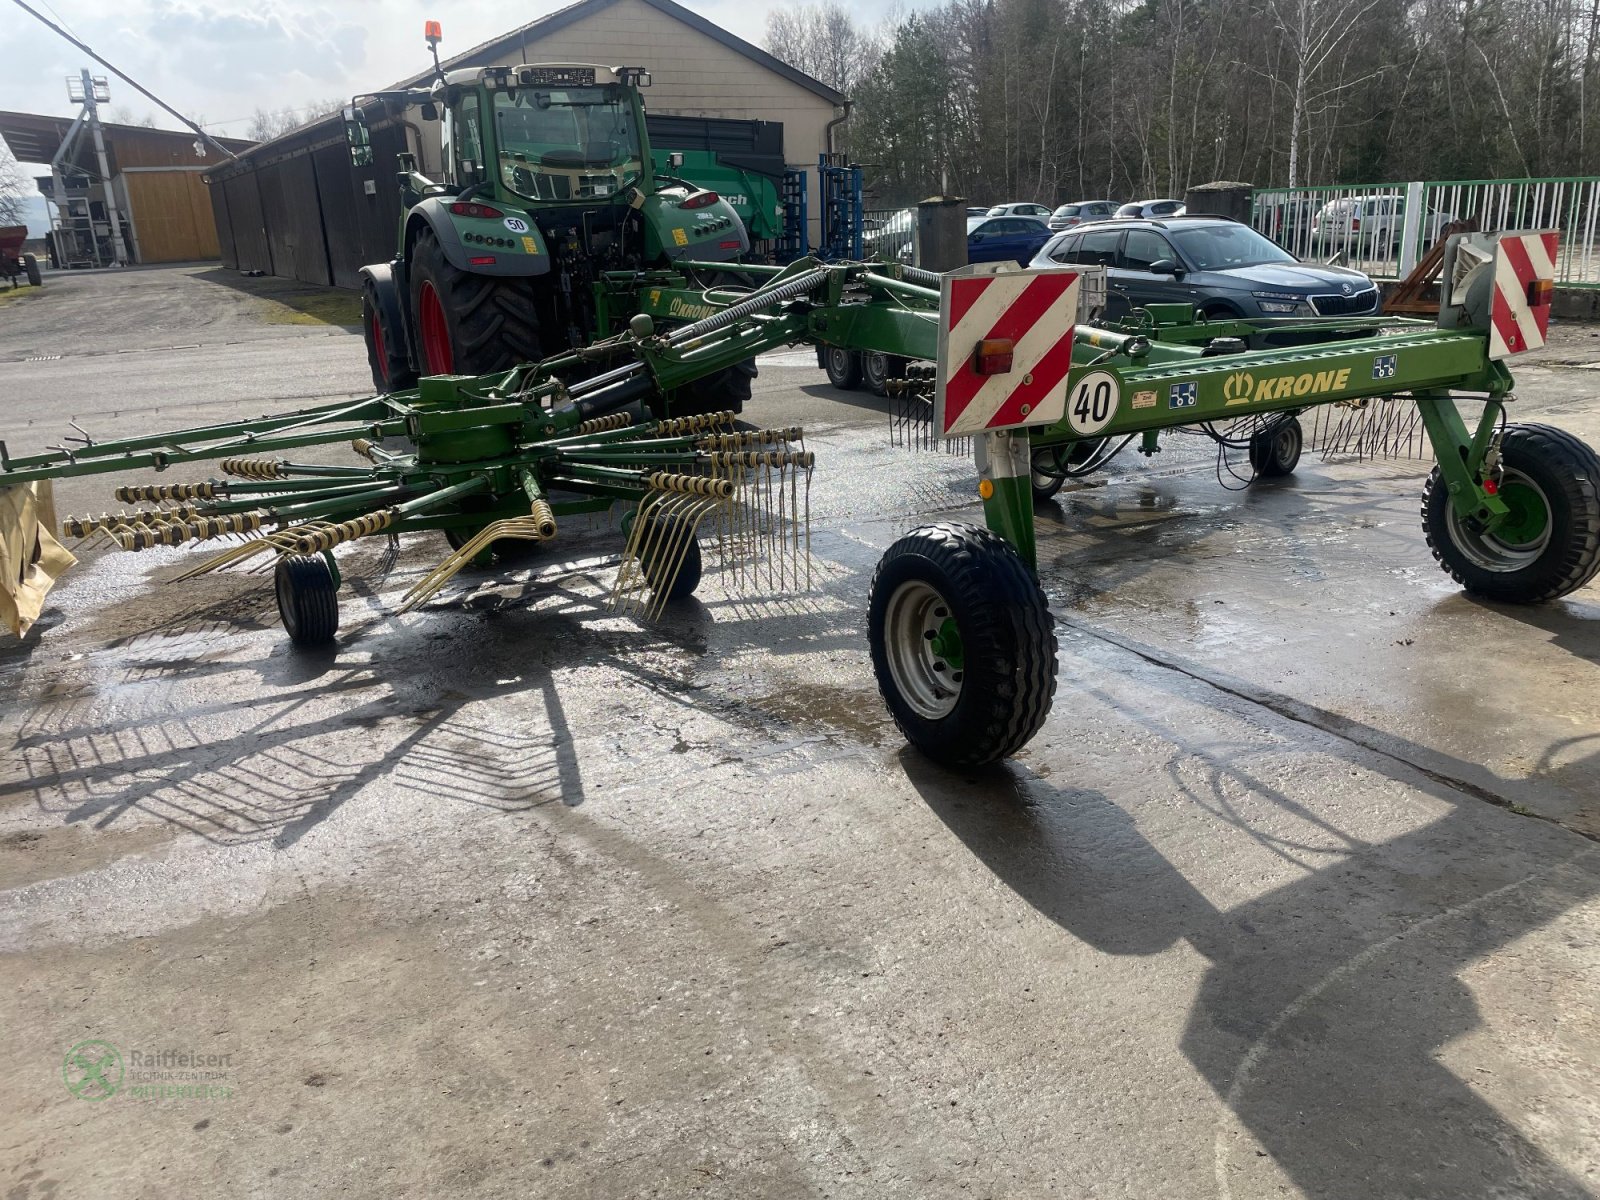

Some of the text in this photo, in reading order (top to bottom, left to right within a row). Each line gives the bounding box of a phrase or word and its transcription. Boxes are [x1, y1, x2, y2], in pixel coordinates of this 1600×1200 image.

[507, 219, 525, 231] 50
[679, 303, 717, 320] KRONE
[1254, 367, 1352, 402] KRONE
[1074, 381, 1111, 424] 40
